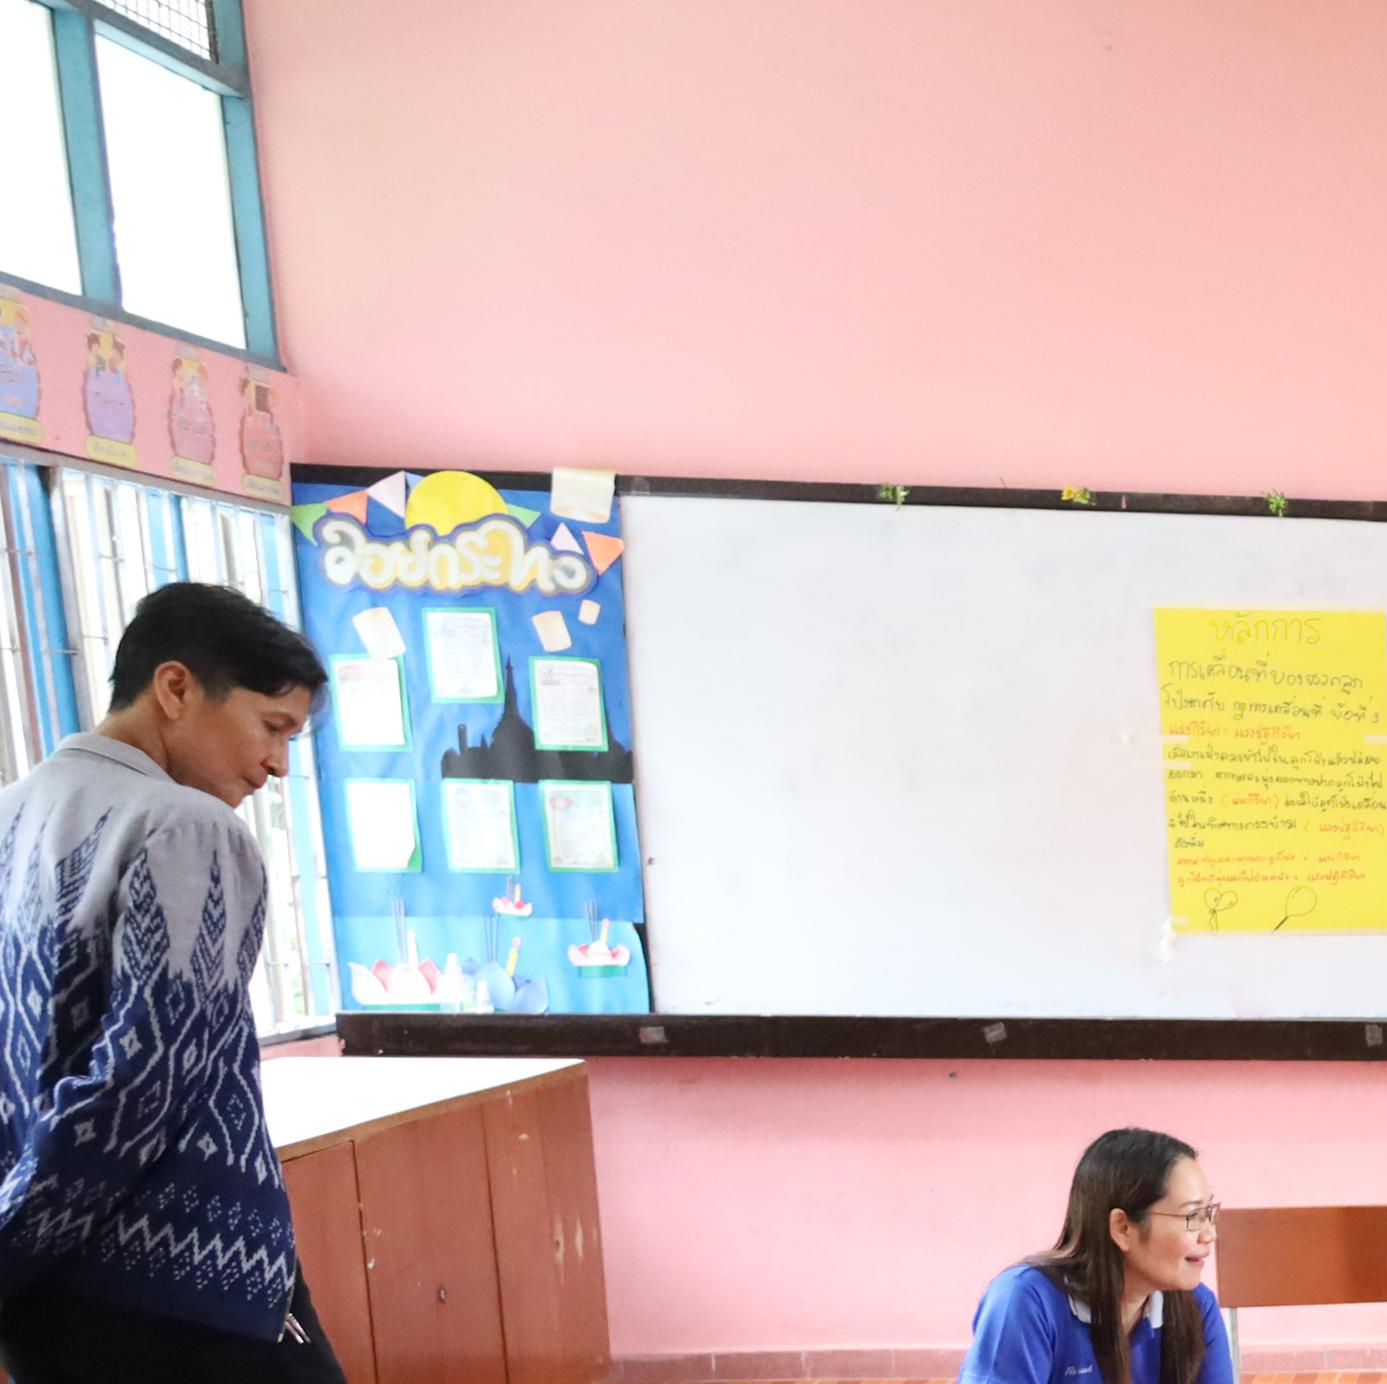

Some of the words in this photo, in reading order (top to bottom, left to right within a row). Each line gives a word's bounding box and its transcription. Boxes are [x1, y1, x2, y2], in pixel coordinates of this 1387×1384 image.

[322, 518, 588, 591] ลอยกระทง
[1210, 612, 1321, 644] หลักการ
